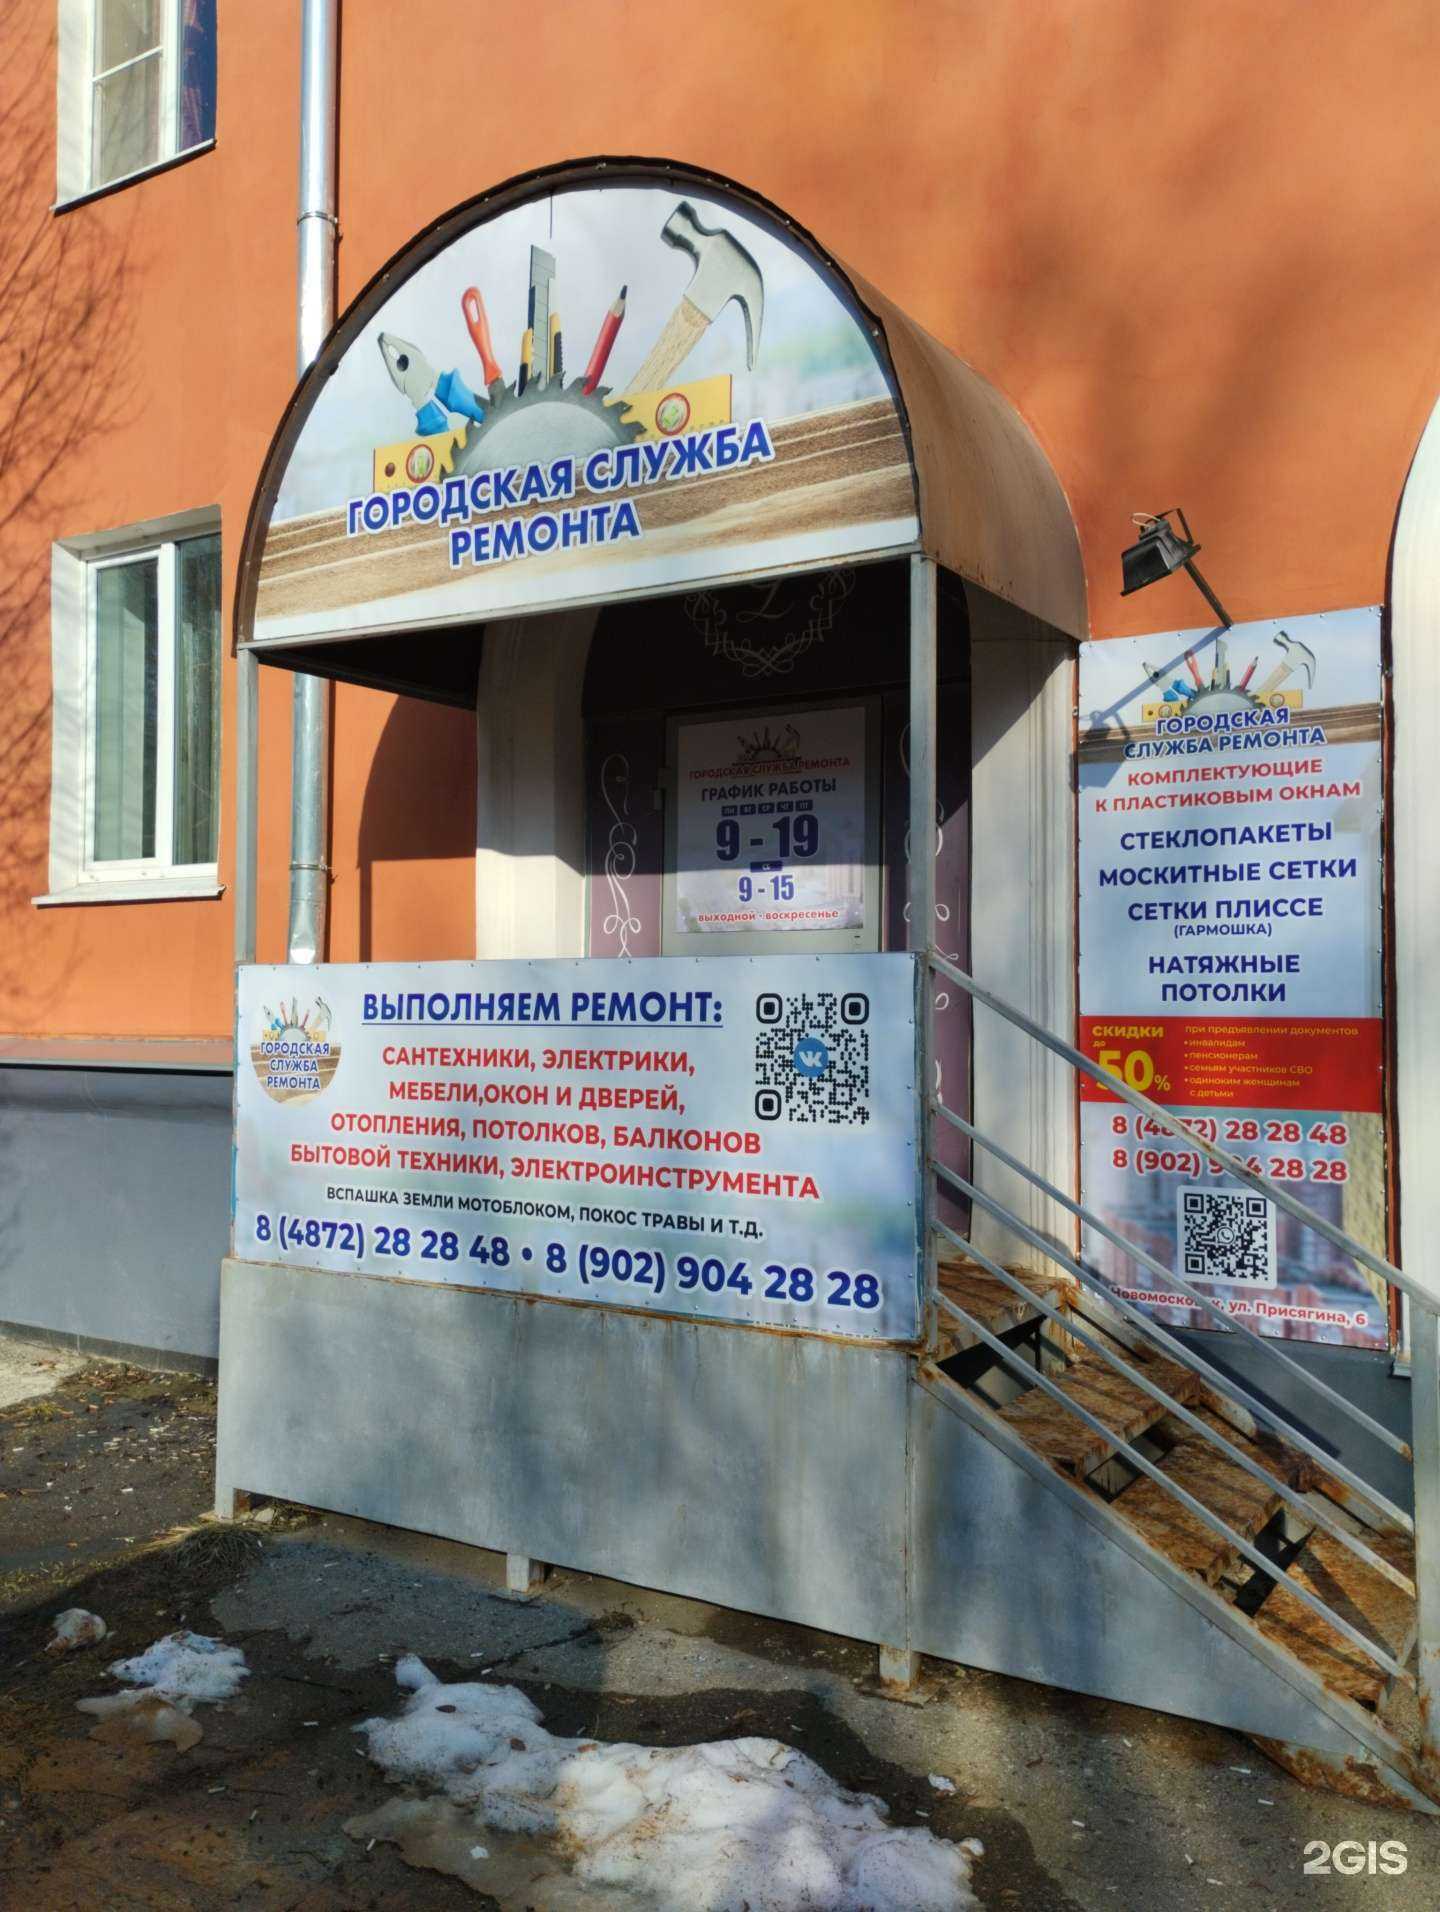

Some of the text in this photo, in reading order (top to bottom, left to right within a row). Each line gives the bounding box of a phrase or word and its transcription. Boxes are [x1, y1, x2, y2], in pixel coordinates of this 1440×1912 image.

[348, 421, 773, 535] ГОРОДСКАЯ СЛУЖБА
[450, 502, 640, 566] РЕМОНТА
[1156, 708, 1290, 735] ГОРОДСКАЯ
[1124, 727, 1326, 759] СЛУЖБА РЕМОНТА
[1128, 759, 1322, 786] КОМПЛЕКТУЮЩИЕ
[702, 779, 836, 801] ГРАФИК РАБОТЫ
[1096, 782, 1361, 813] К ПЛАСТИКОВЫМ ОКНАМ
[716, 819, 740, 861] 9
[772, 814, 819, 858] 19
[1120, 821, 1332, 851] СТЕКЛОПАКЕТЫ
[1099, 859, 1357, 887] МОСКИТНЫЕ СЕТКИ
[739, 876, 752, 902] 9
[770, 875, 794, 900] 15
[698, 911, 756, 922] выходной
[765, 910, 839, 921] воскресенье
[1128, 897, 1323, 921] СЕТКИ ПЛИССЕ
[1174, 923, 1272, 939] (ГАРМОШКА)
[1149, 954, 1300, 974] НАТЯЖНЫЕ
[1161, 984, 1286, 1002] ПОТОЛКИ
[363, 991, 723, 1023] ВЫПОЛНЯЕМ РЕМОНТ:
[1185, 1026, 1359, 1036] при предъявлении документов
[260, 1042, 330, 1056] ГОРОДСКАЯ
[382, 1047, 696, 1077] САНТЕХНИКИ, ЭЛЕКТРИКИ,
[1189, 1052, 1258, 1060] пенсионерам
[270, 1059, 318, 1072] СЛУЖБА
[1228, 1065, 1287, 1075] участников
[1289, 1066, 1313, 1074] СВО
[267, 1076, 320, 1089] РЕМОНТА
[556, 1086, 572, 1106] И
[579, 1085, 685, 1115] ДВЕРЕЙ,
[331, 1113, 761, 1154] ОТОПЛЕНИЯ, ПОТОЛКОВ, БАЛКОНОВ
[1112, 1115, 1127, 1134] 8
[1226, 1120, 1258, 1140] 28
[1266, 1123, 1300, 1143] 28
[1309, 1125, 1347, 1144] 48
[291, 1144, 819, 1199] БЫТОВОЙ ТЕХНИКИ, ЭЛЕКТРОИНСТРУМЕНТА
[1113, 1149, 1348, 1181] 8 (902) 94 28 28
[327, 1187, 763, 1240] ВСПАШКА ЗЕМЛИ МОТОБЛОКОМ, ПОКОС ТРАВЫ И Т.Д.
[256, 1215, 880, 1308] 8 (4872) 28 28 48 8 (902) 904 28 28
[1229, 1299, 1251, 1313] ул.
[1256, 1303, 1350, 1325] Присягина,
[1356, 1313, 1366, 1325] 6
